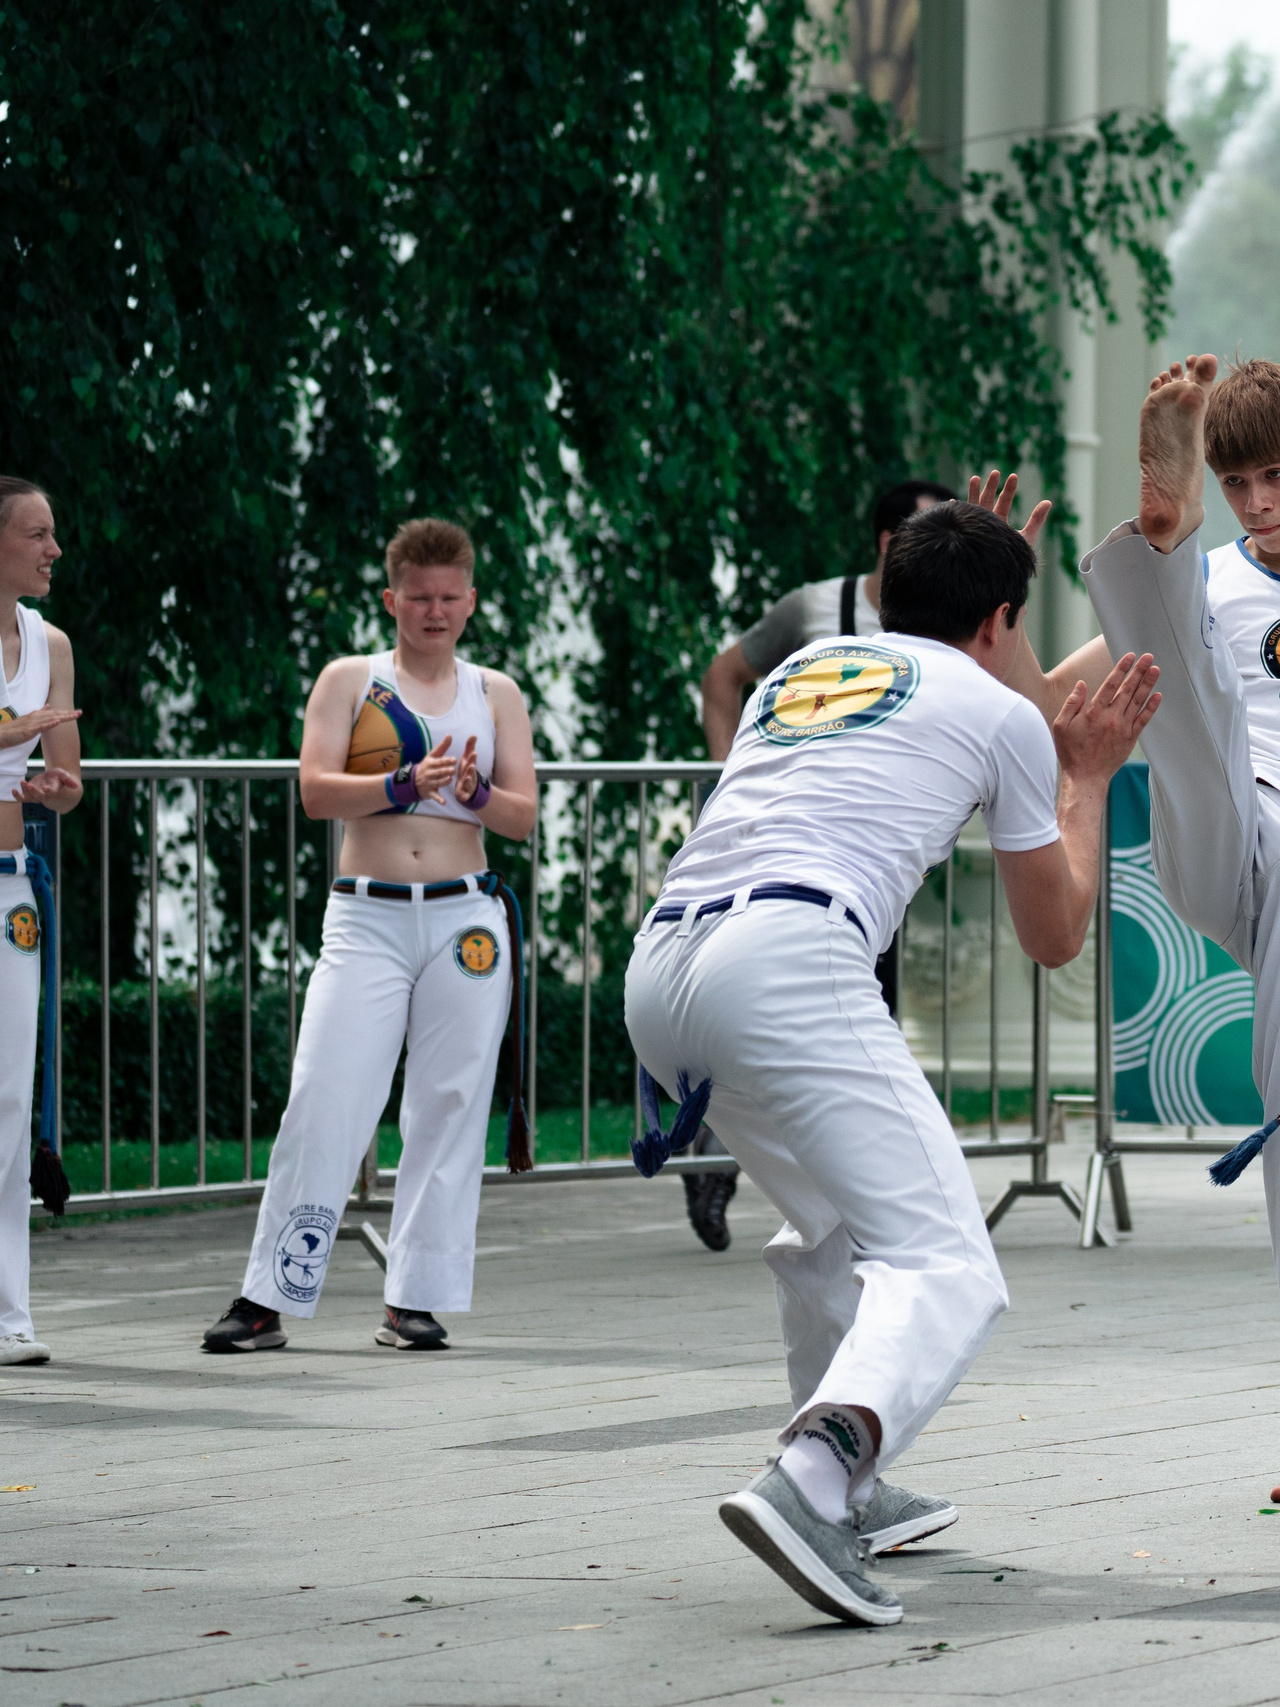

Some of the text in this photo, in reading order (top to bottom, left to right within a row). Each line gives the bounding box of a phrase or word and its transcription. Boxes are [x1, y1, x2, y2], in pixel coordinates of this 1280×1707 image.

[799, 649, 845, 668] GRUPO
[848, 649, 875, 658] AXÉ
[795, 721, 845, 737] BARRÃO
